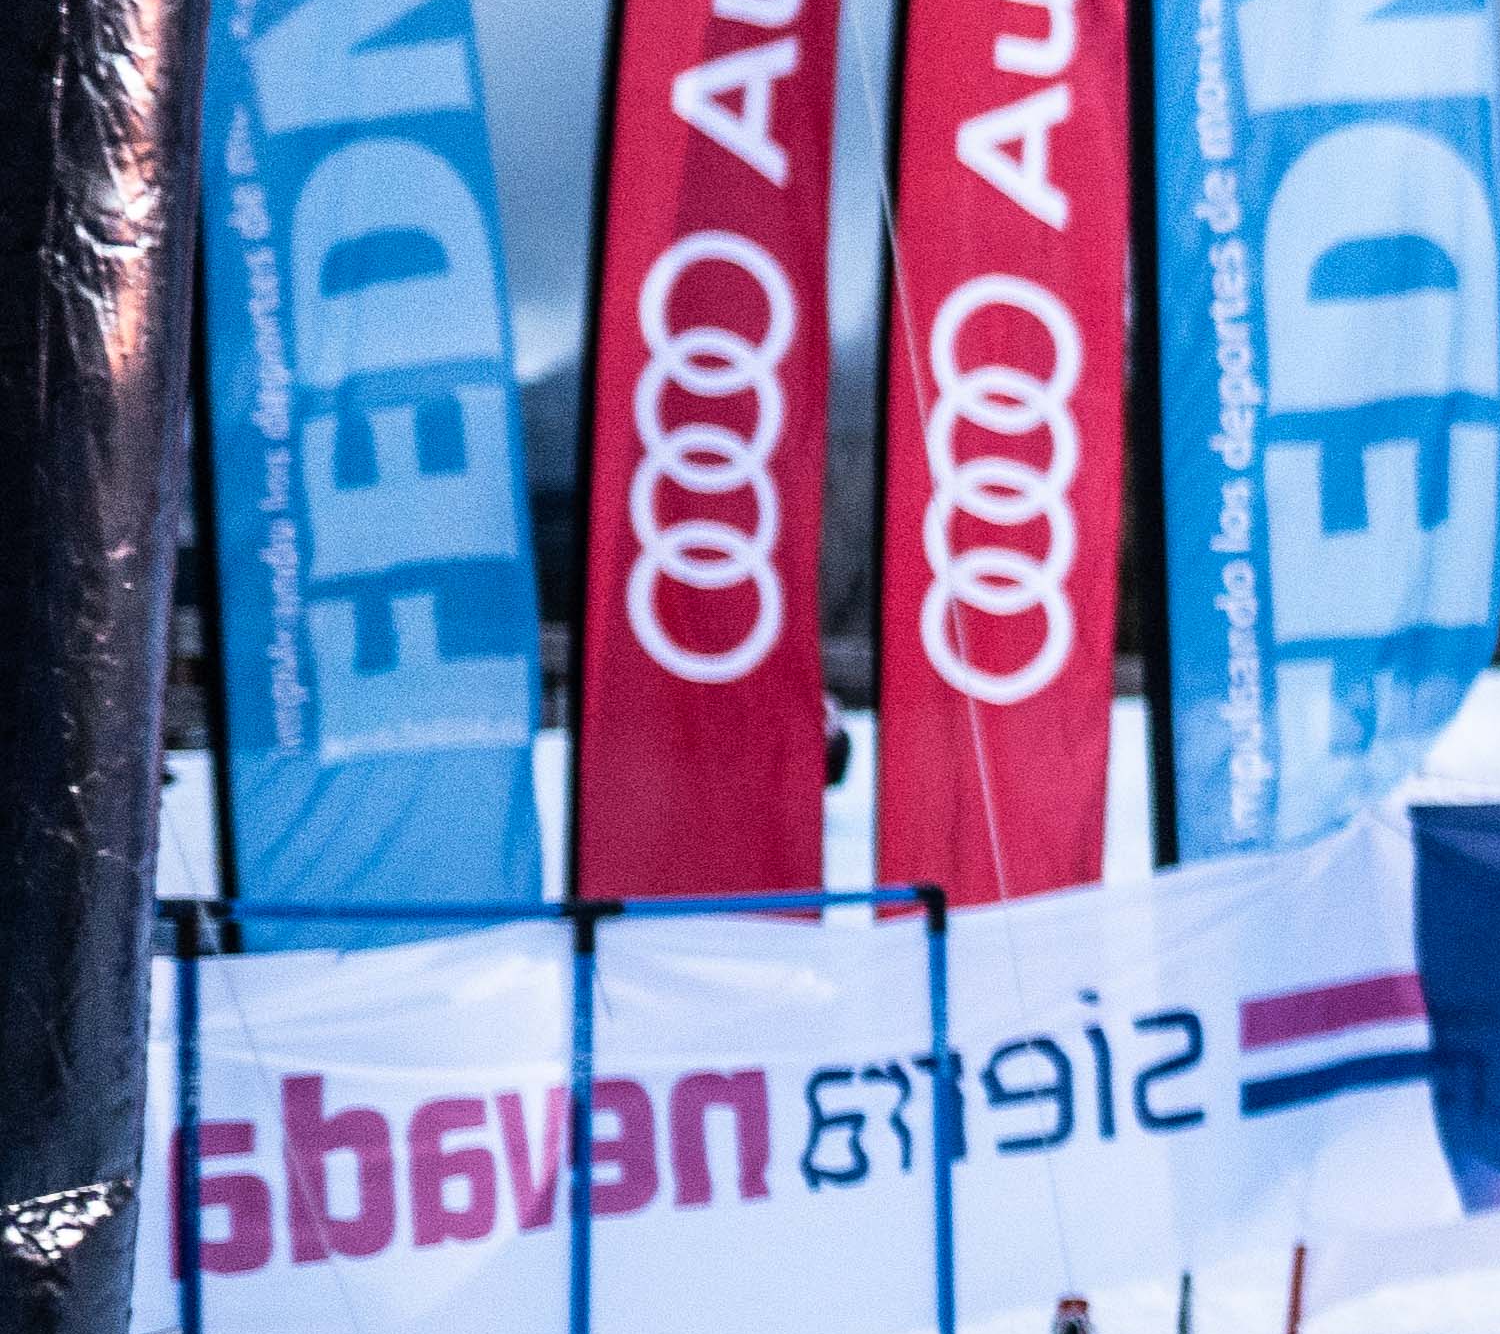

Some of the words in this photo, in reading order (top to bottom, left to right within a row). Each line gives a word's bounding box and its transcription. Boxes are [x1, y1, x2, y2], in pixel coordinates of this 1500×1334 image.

[1195, 174, 1240, 227] de
[1206, 237, 1261, 469] deportes
[1210, 479, 1253, 553] los
